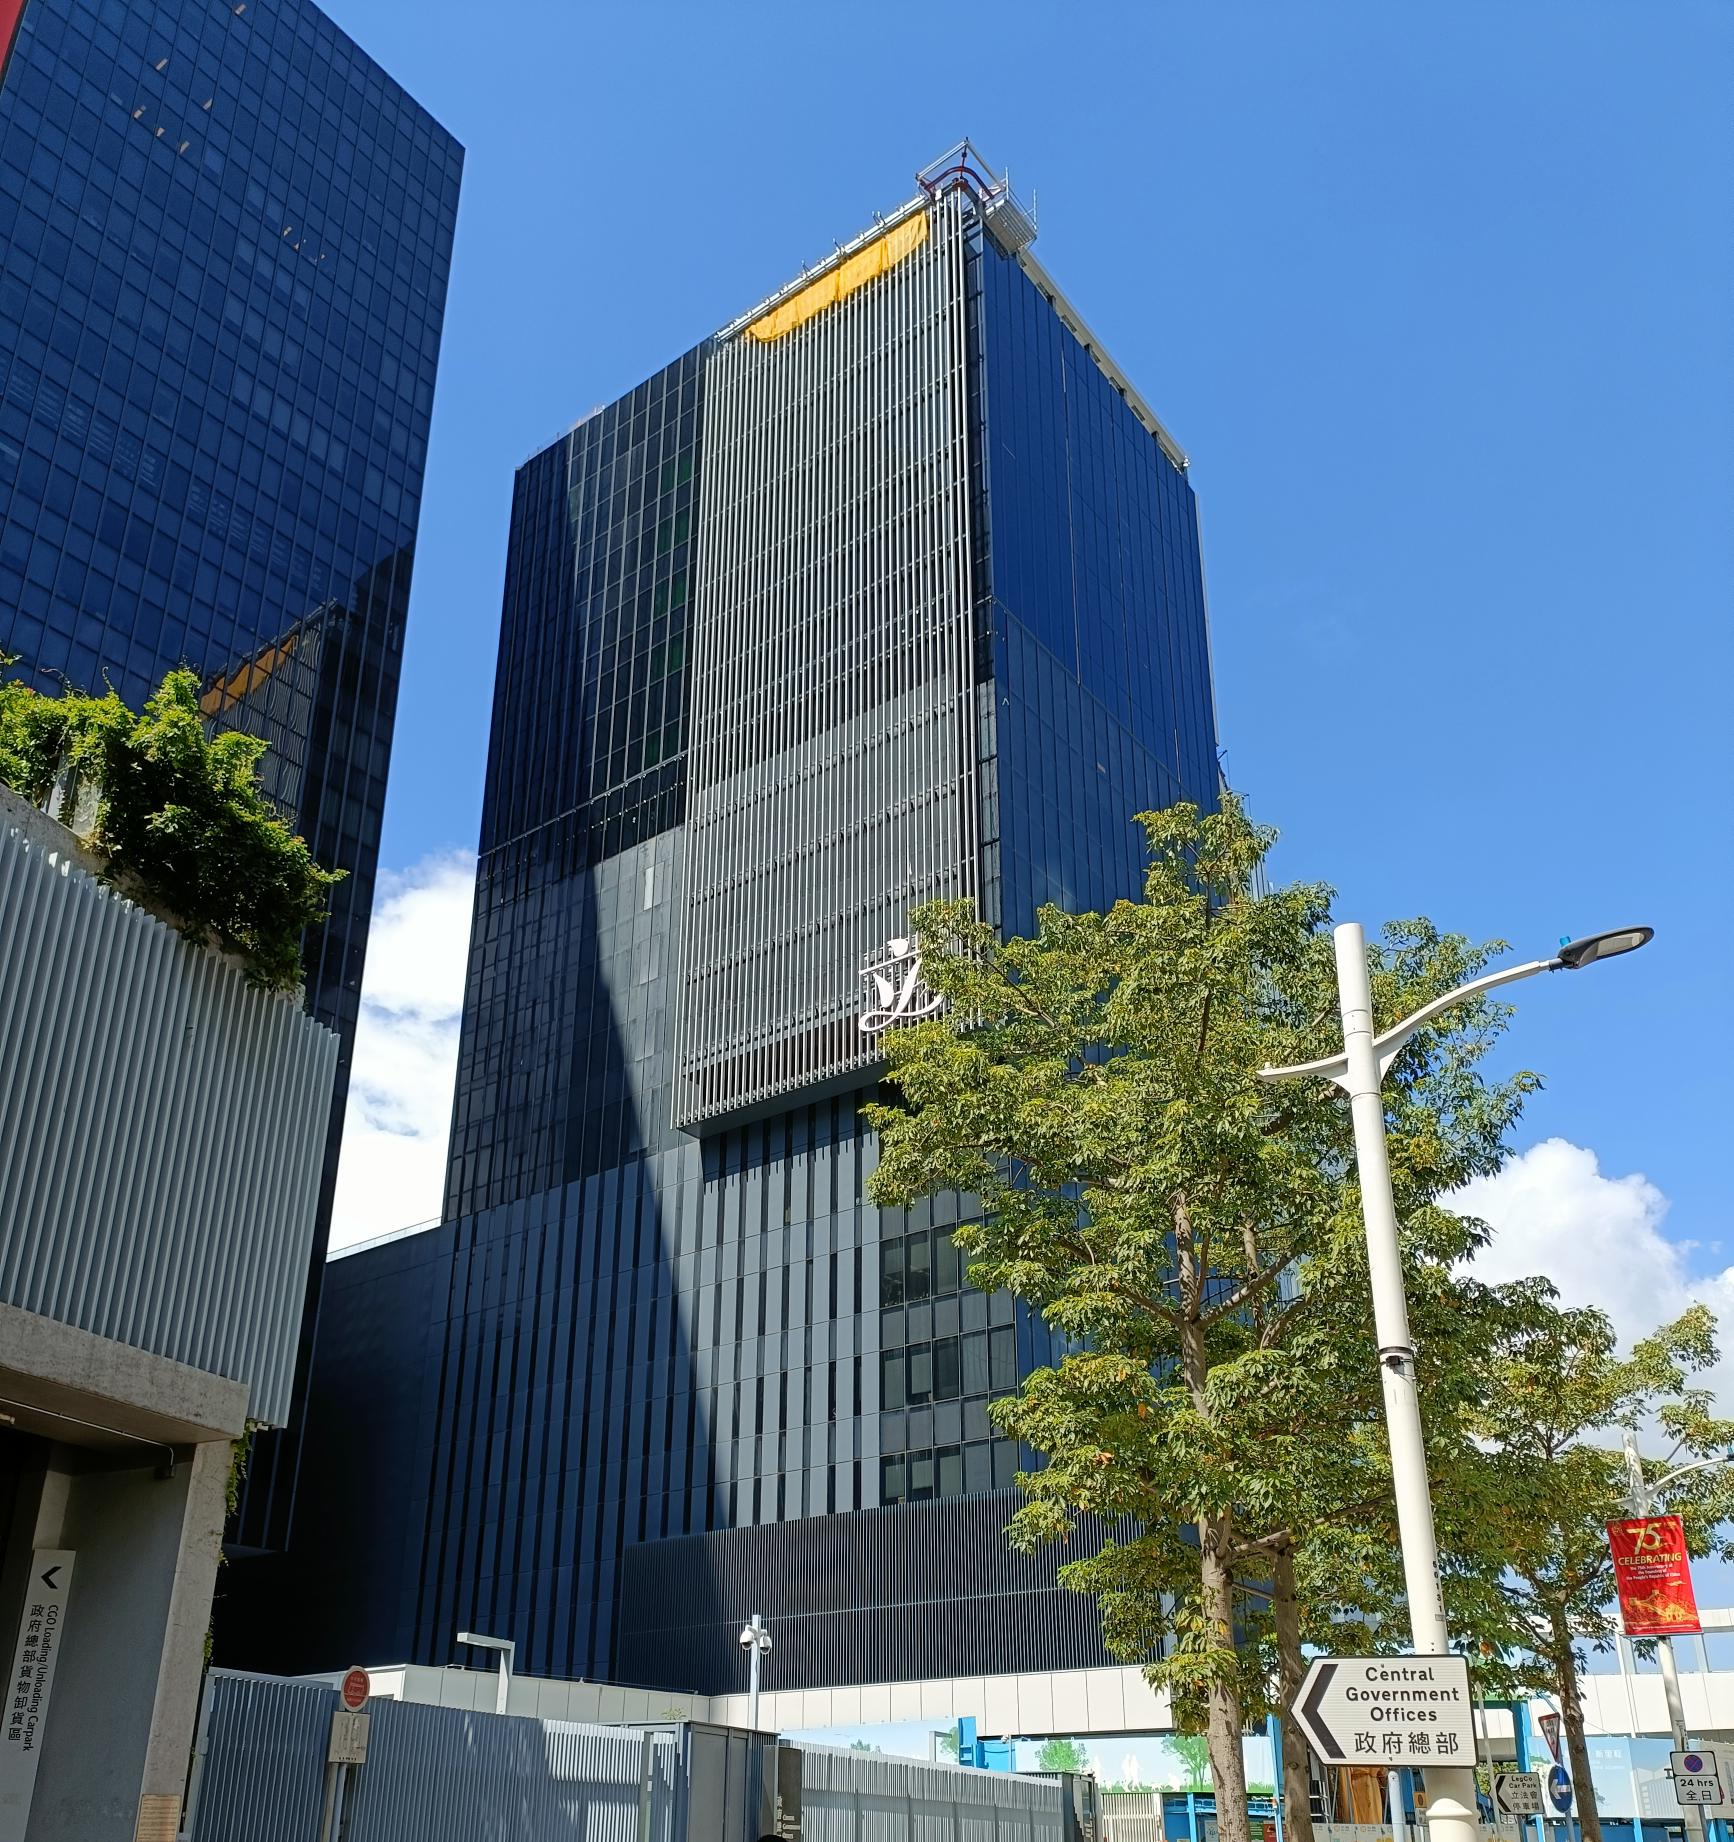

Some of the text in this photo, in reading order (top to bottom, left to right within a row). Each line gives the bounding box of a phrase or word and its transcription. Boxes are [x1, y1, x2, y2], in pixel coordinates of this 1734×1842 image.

[1626, 1522, 1662, 1555] 75
[1618, 1552, 1682, 1566] CELEBRATING
[8, 1603, 45, 1741] 政府總部貨物卸貨區
[22, 1604, 59, 1752] CGO Loading/Unloading Carpark
[1365, 1666, 1434, 1682] Central
[1345, 1686, 1460, 1702] Government
[1370, 1706, 1438, 1722] Offices
[1354, 1731, 1459, 1755] 政府總部
[1511, 1775, 1533, 1783] LegCo
[1680, 1779, 1714, 1787] 24 hrs
[1511, 1790, 1538, 1800] 立法會
[1686, 1789, 1712, 1801] 全日
[1512, 1801, 1540, 1811] 停車場
